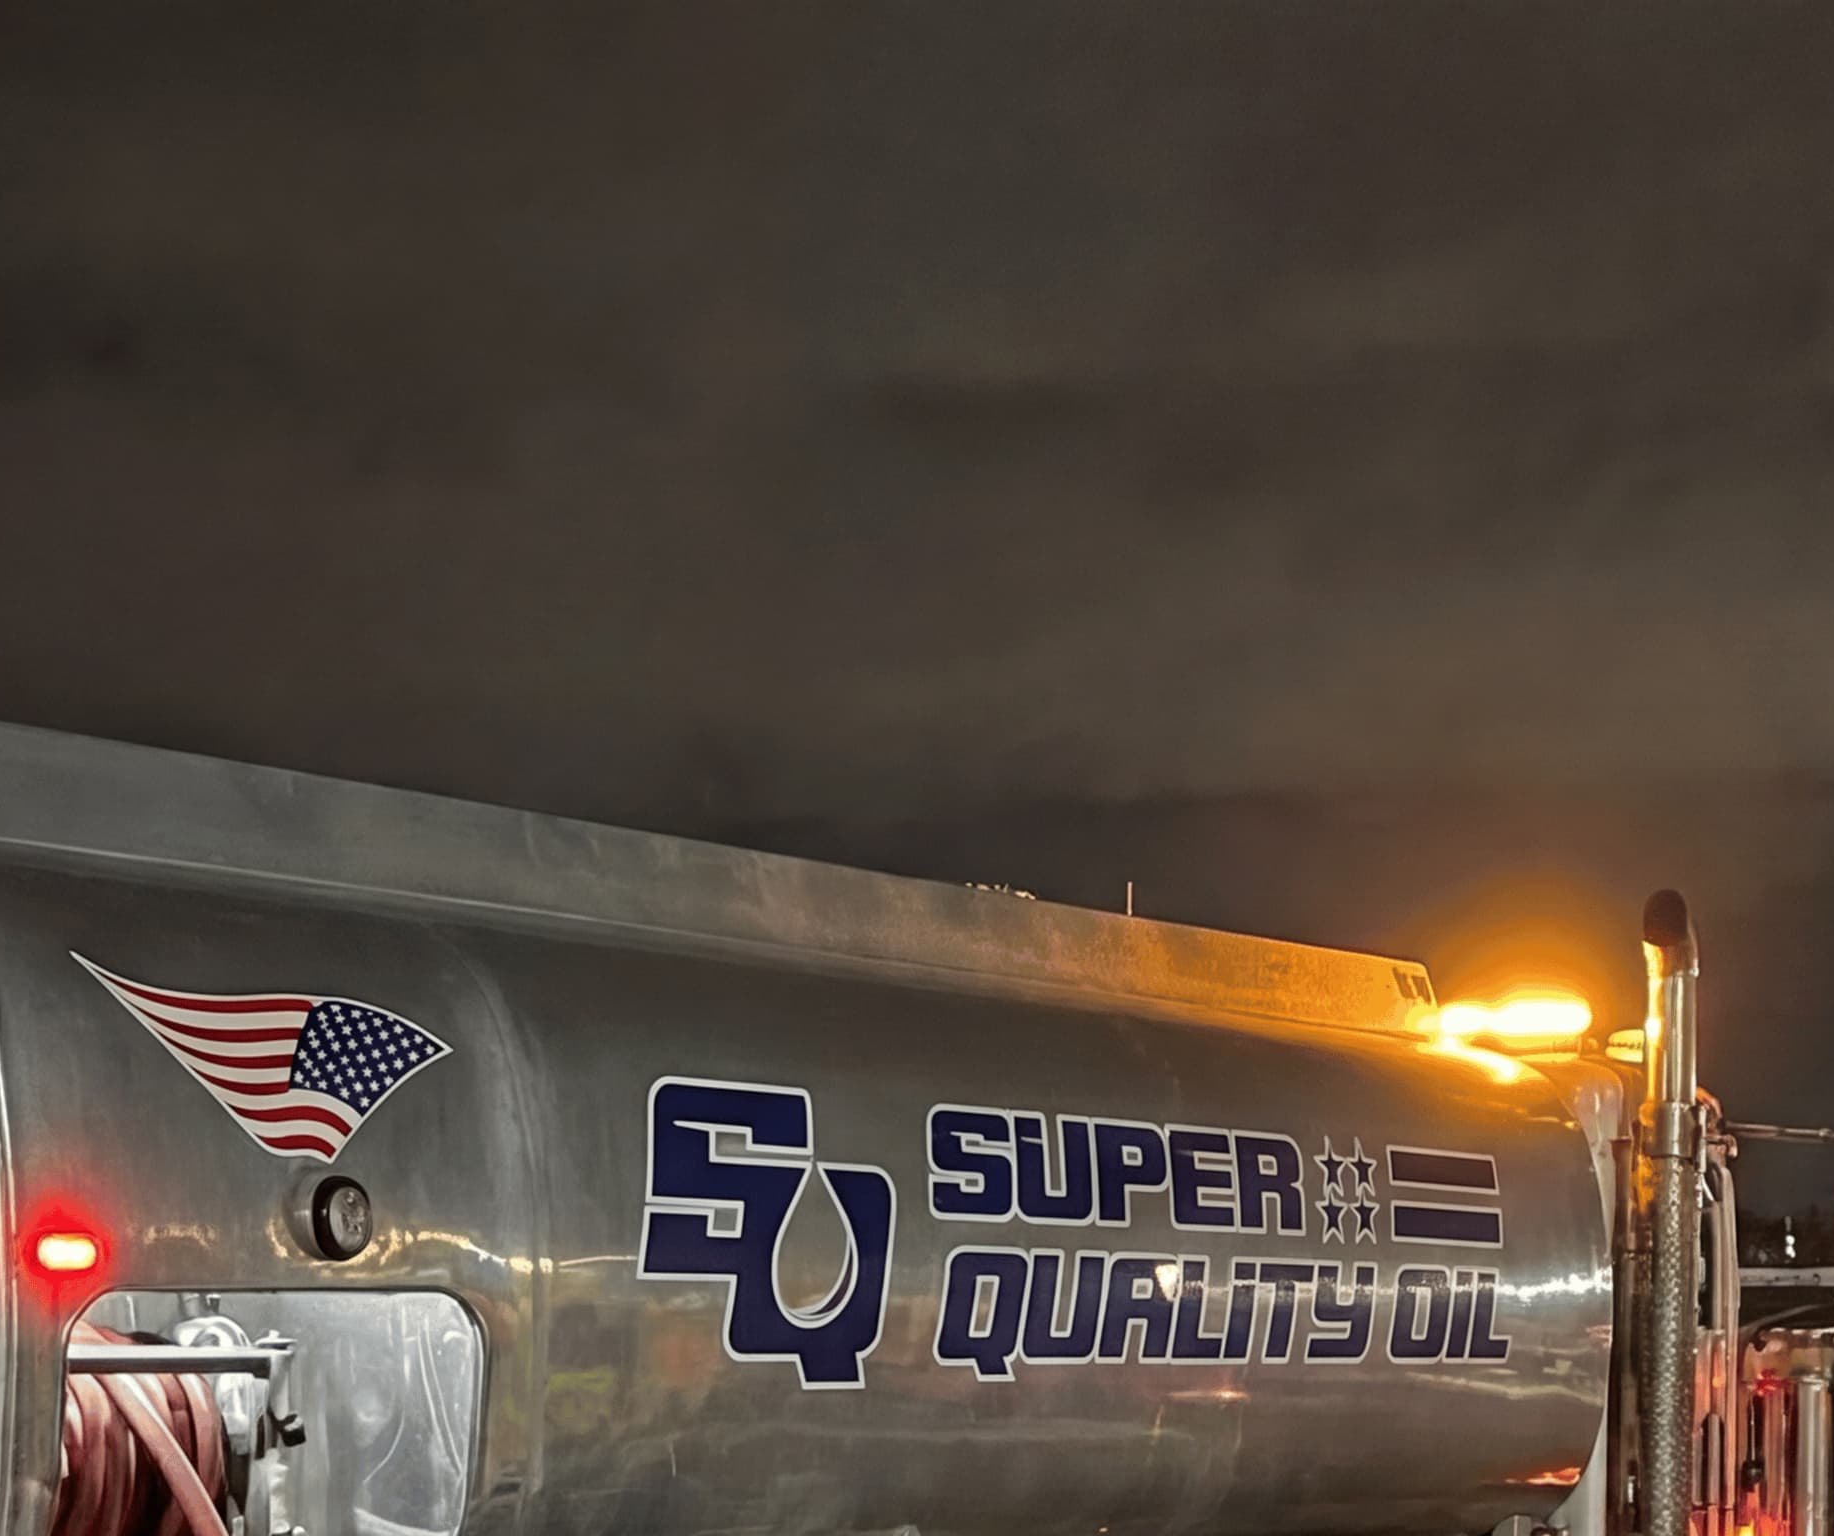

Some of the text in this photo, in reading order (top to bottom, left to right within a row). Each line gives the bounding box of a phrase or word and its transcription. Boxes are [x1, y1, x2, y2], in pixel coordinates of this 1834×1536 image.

[926, 1103, 1307, 1236] SUPER
[937, 1244, 1512, 1383] QUALITY OIL
